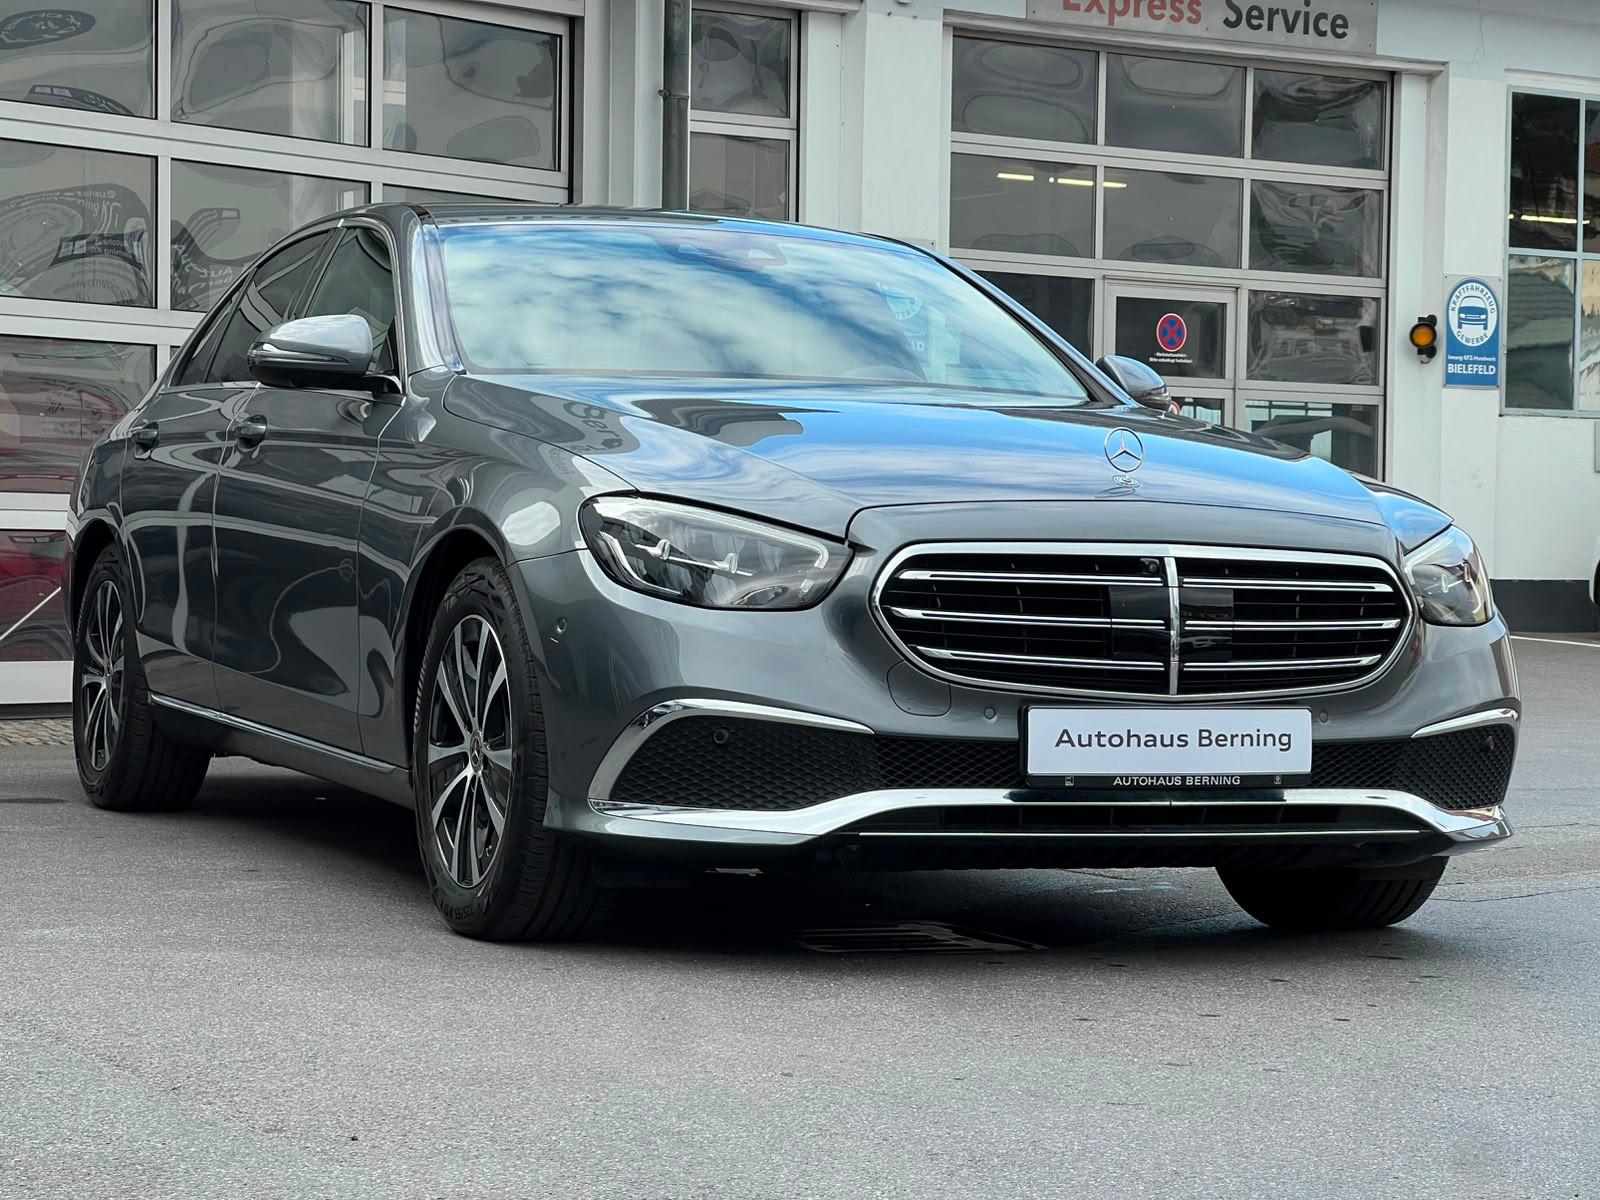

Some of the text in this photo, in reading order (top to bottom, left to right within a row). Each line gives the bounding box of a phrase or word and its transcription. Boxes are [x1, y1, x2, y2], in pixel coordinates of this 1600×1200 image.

[1223, 0, 1349, 39] Service
[1451, 285, 1495, 314] KRAFTFAHRZEUG
[1456, 330, 1487, 344] GEWERBE
[1447, 363, 1496, 374] BIELEFELD
[1054, 728, 1292, 752] Autohaus Berning
[1113, 776, 1241, 787] AUTOHAUS BERNING
